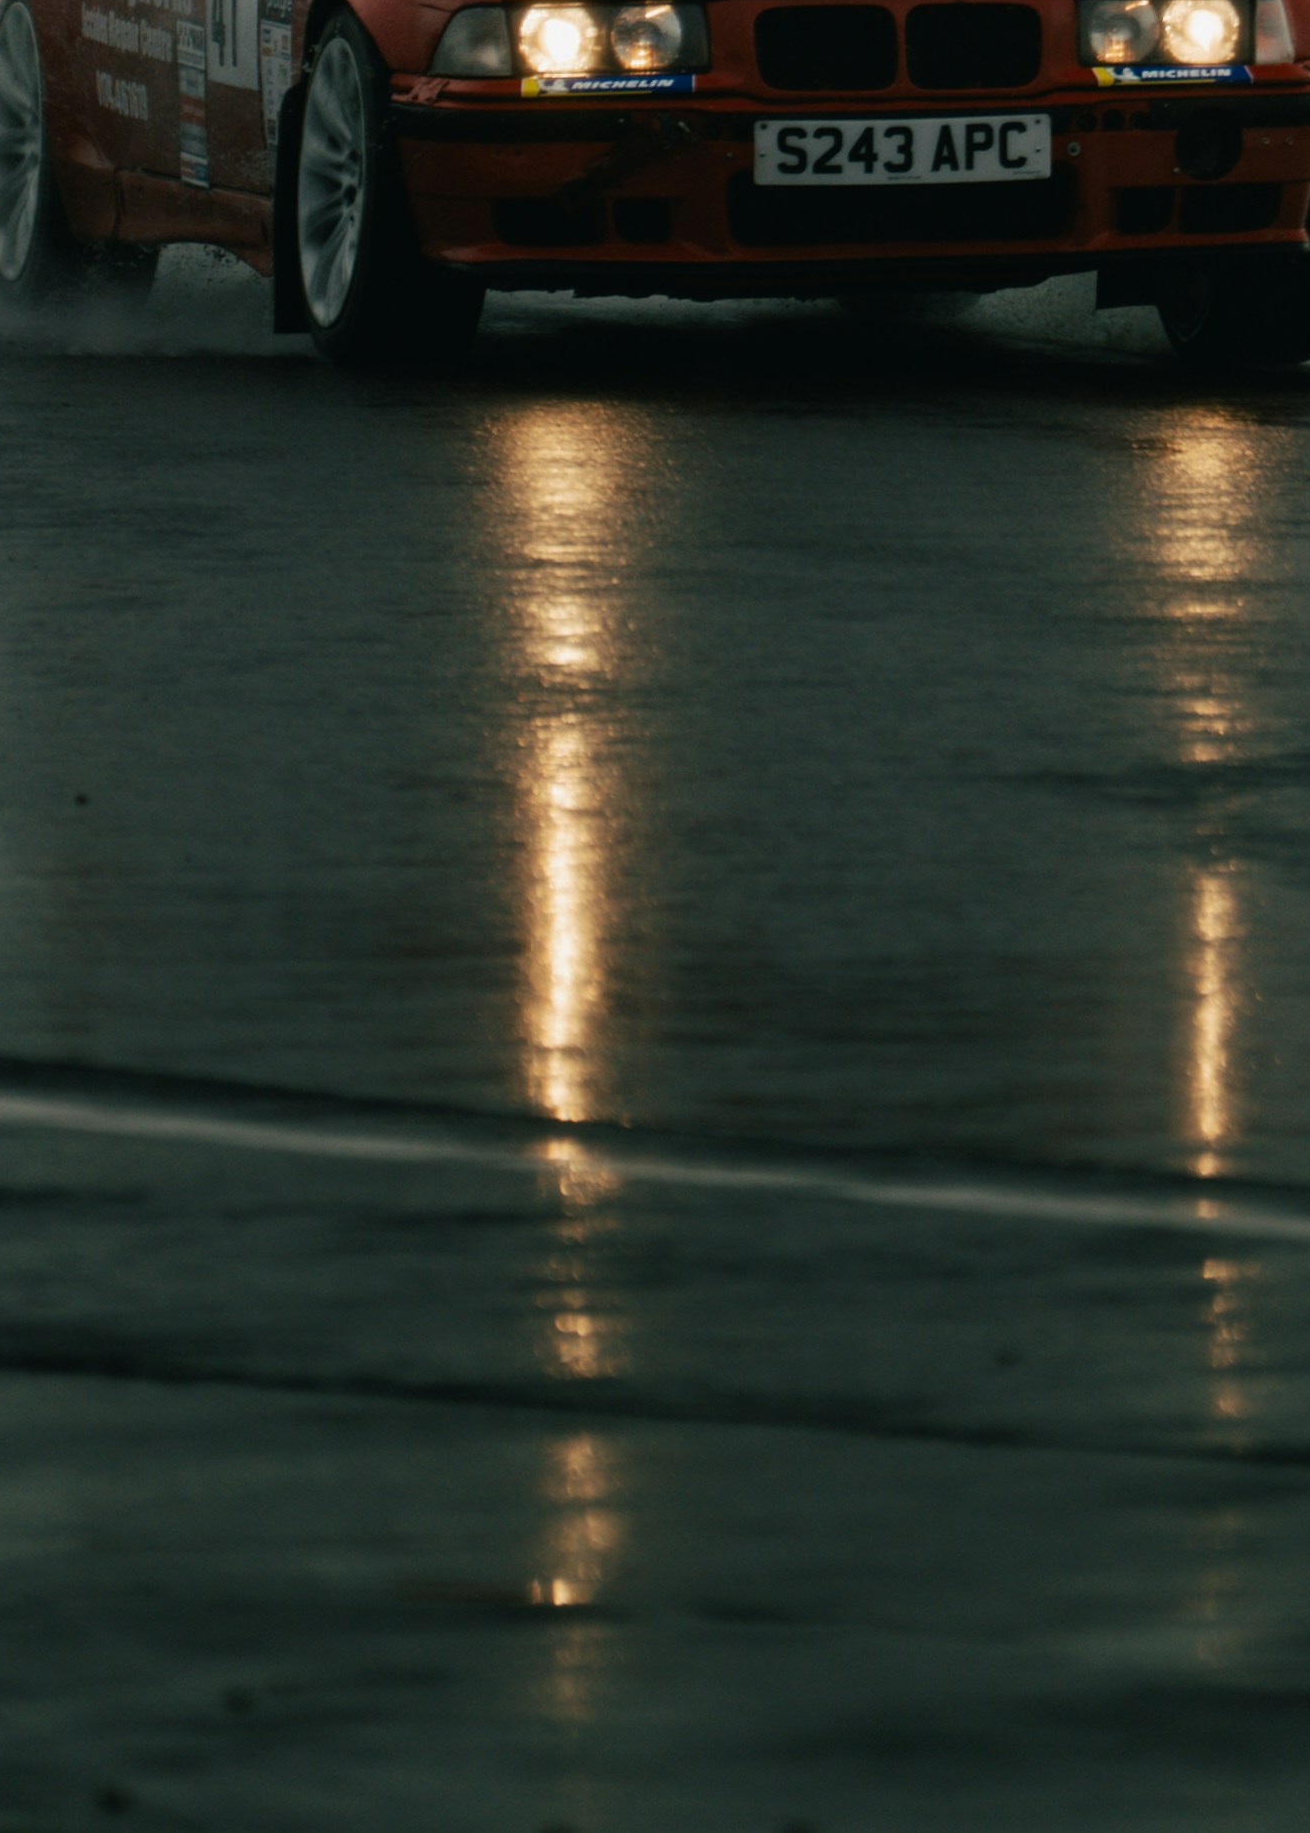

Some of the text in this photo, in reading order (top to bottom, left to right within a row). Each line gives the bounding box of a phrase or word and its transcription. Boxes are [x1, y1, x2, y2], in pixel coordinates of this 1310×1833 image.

[1141, 68, 1232, 79] MICHELIN
[571, 78, 675, 91] MICHELIN
[777, 121, 1027, 174] S243 APC
